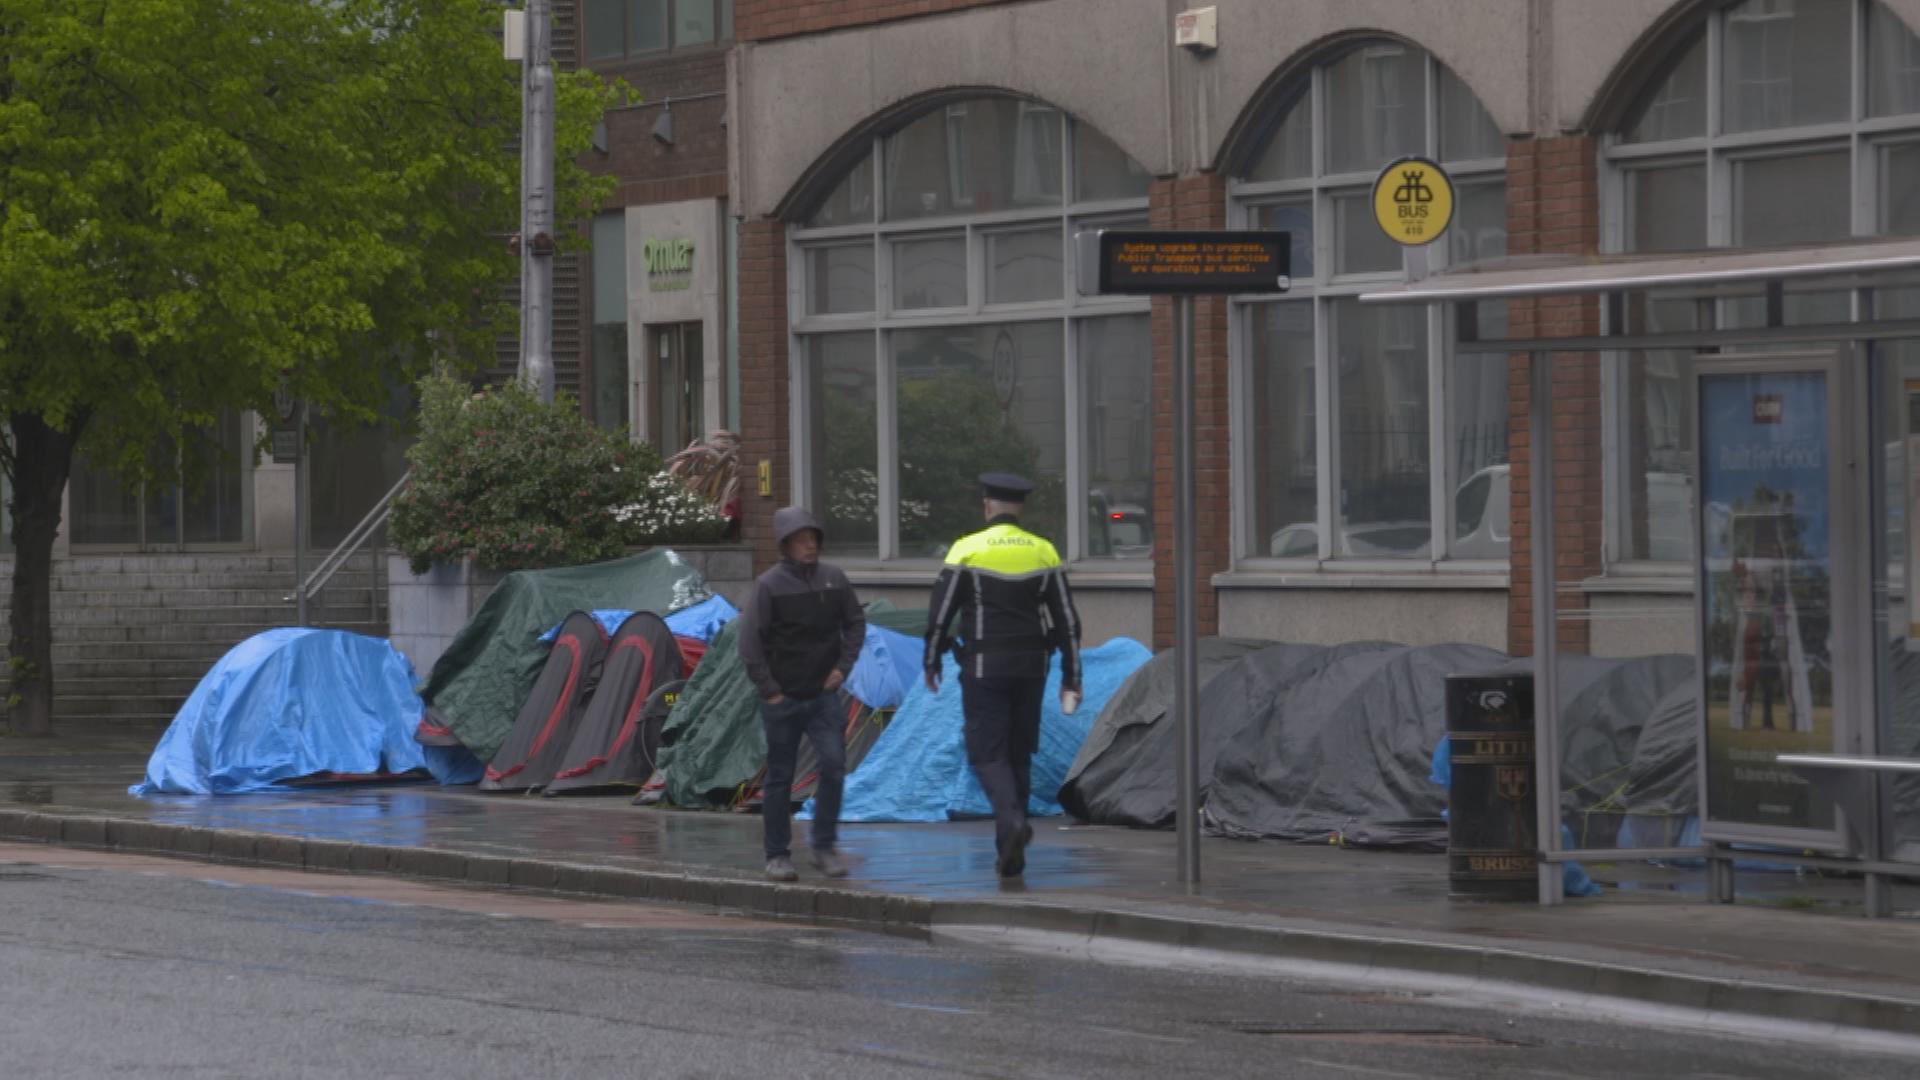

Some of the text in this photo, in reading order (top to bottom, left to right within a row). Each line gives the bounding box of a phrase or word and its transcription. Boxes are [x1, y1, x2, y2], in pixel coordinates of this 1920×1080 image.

[1398, 204, 1429, 218] BUS
[1123, 242, 1157, 251] System
[1160, 242, 1196, 252] upgrade
[1202, 242, 1213, 251] in
[1119, 253, 1270, 263] Public Transport bus services
[1130, 263, 1255, 274] are operating as normal.
[986, 537, 1034, 547] GARDA
